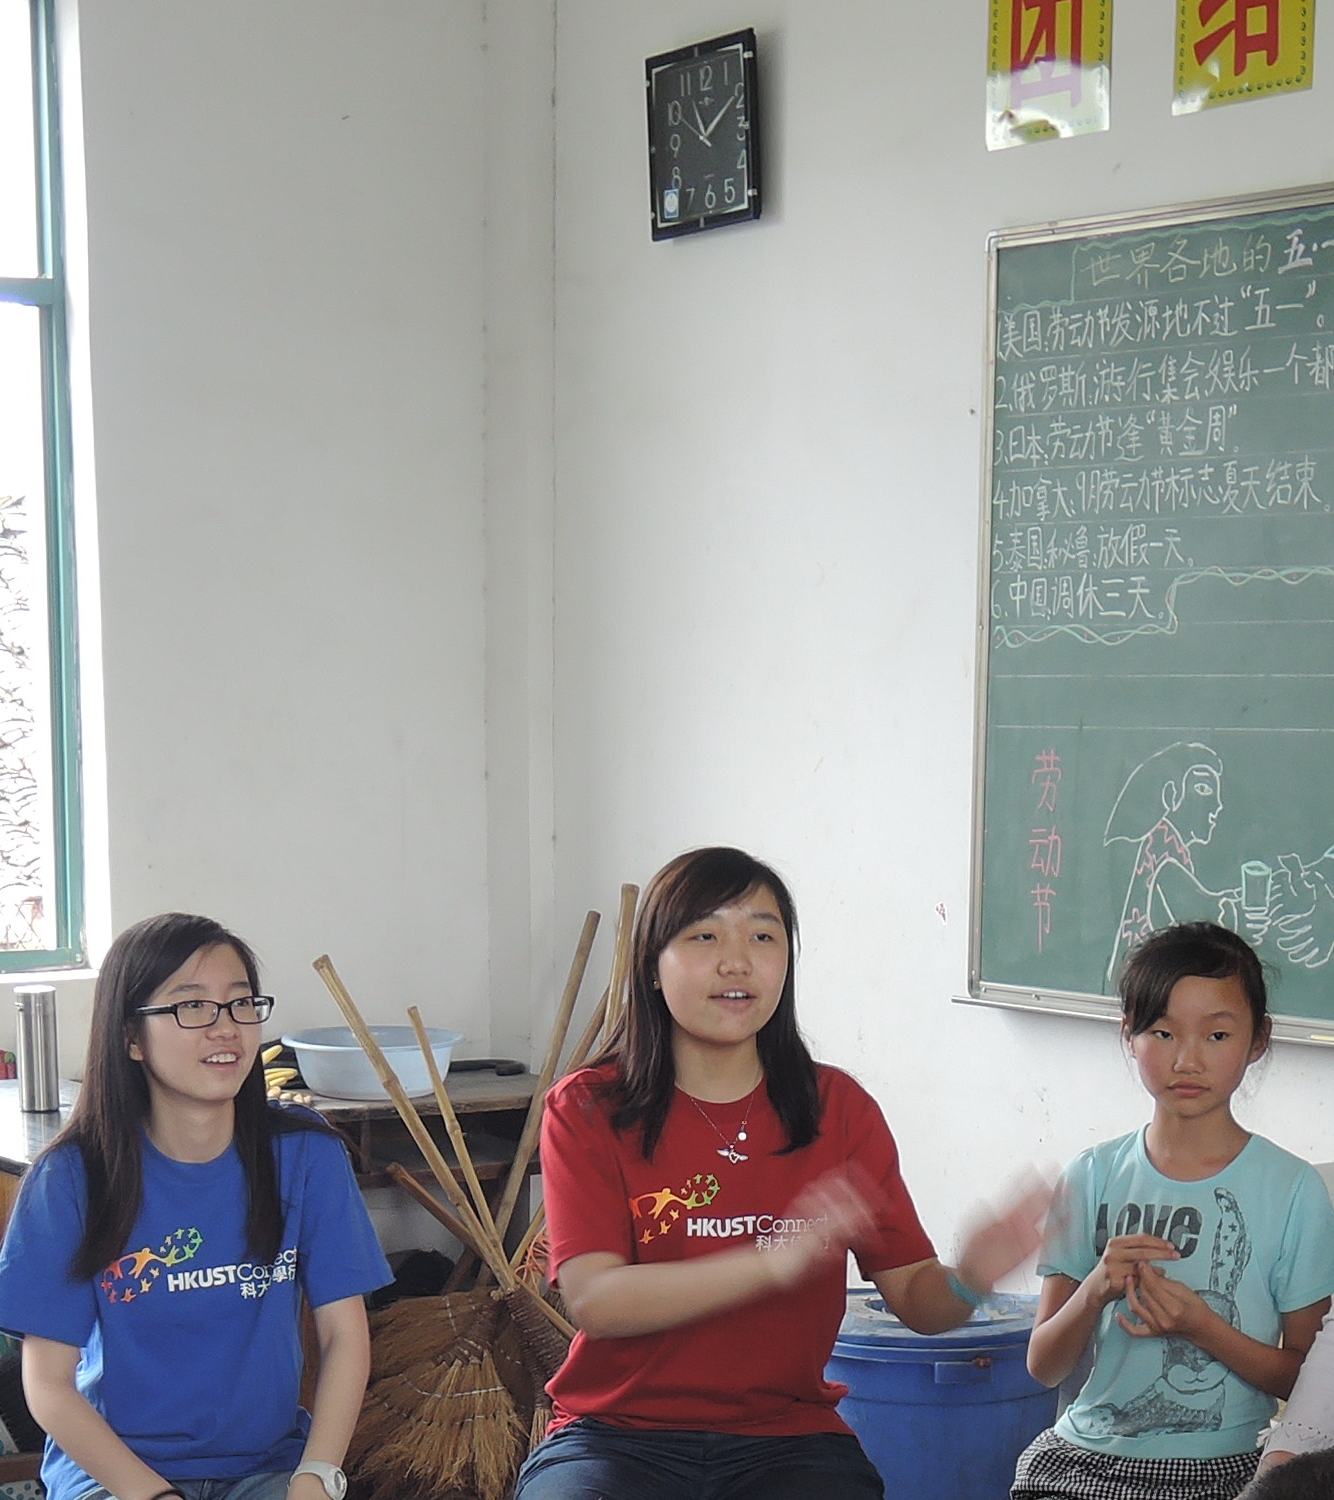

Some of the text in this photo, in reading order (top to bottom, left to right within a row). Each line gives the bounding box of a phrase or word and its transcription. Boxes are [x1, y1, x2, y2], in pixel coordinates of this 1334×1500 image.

[670, 133, 681, 158] 9
[705, 184, 717, 209] 6
[724, 178, 736, 203] 5
[1029, 748, 1063, 954] 劳动节
